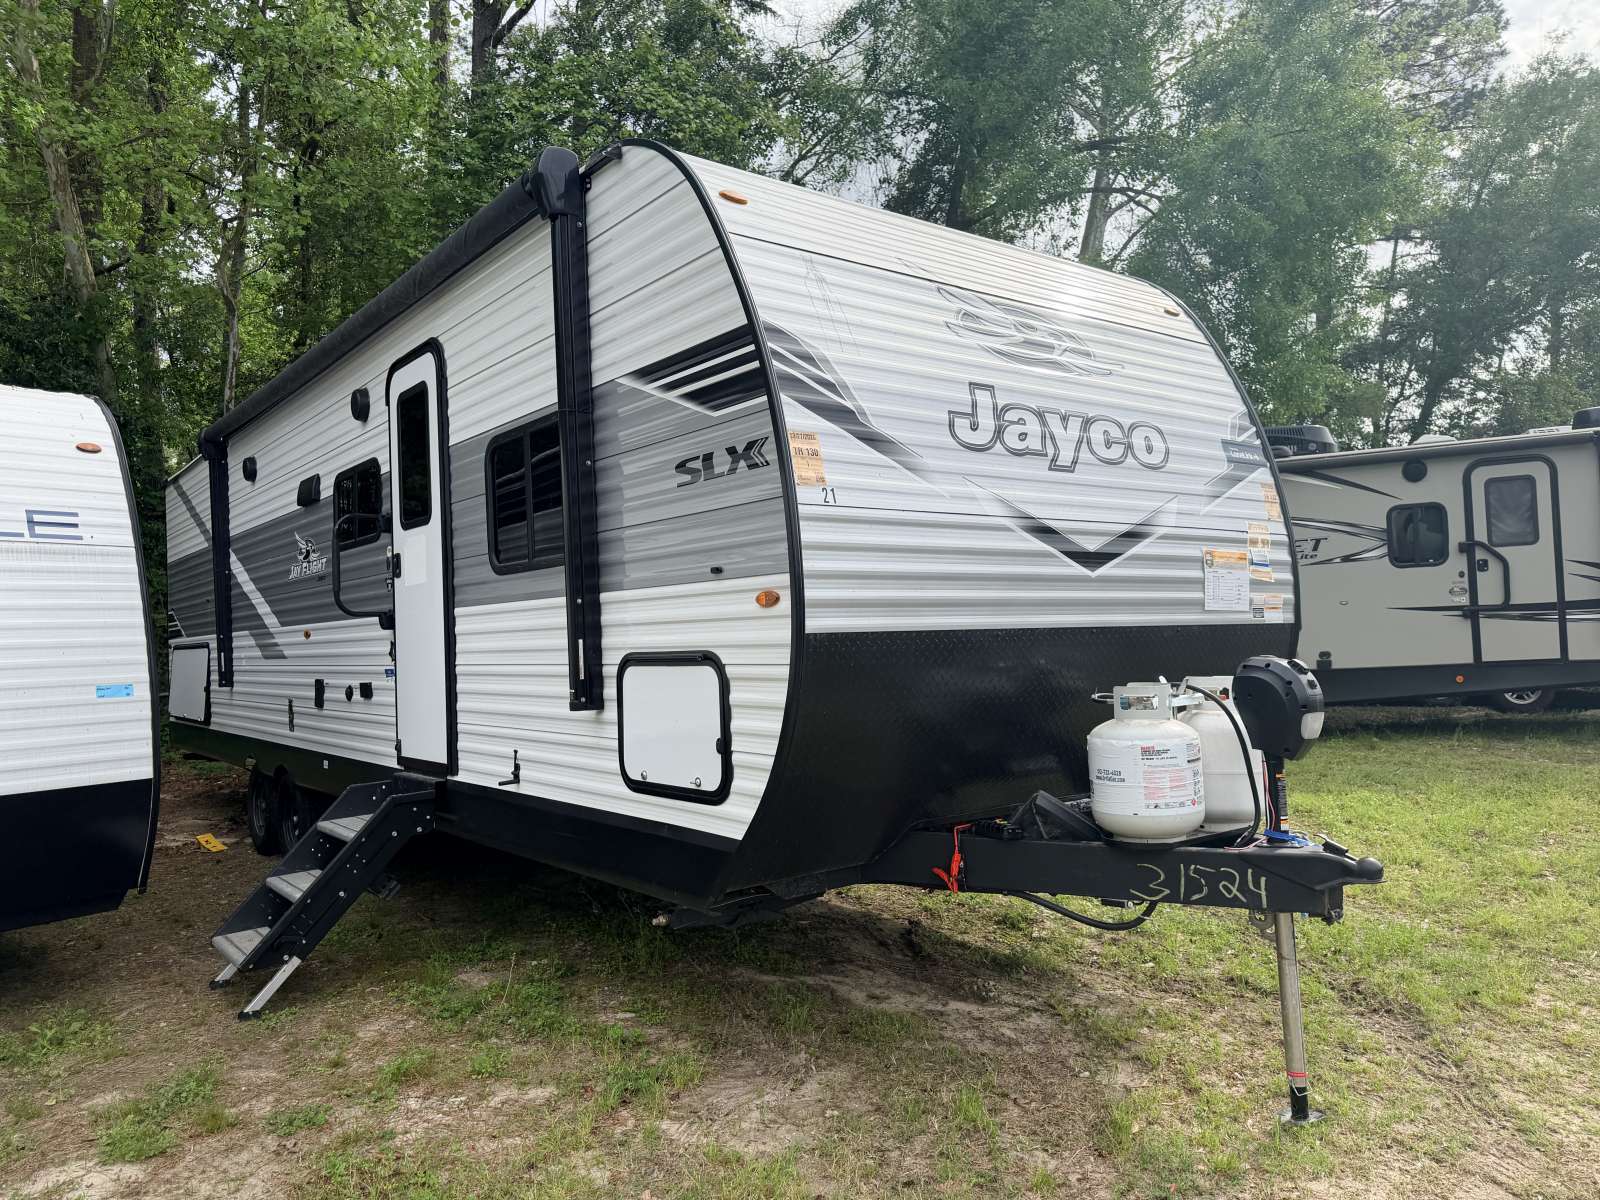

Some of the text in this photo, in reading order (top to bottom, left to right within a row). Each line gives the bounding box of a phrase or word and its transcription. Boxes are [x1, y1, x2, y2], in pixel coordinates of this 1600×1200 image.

[948, 382, 1170, 473] Jayco
[674, 436, 770, 488] SLX
[821, 487, 837, 504] 21
[288, 557, 328, 581] JAY FLIGHT
[1129, 863, 1268, 909] 31524
